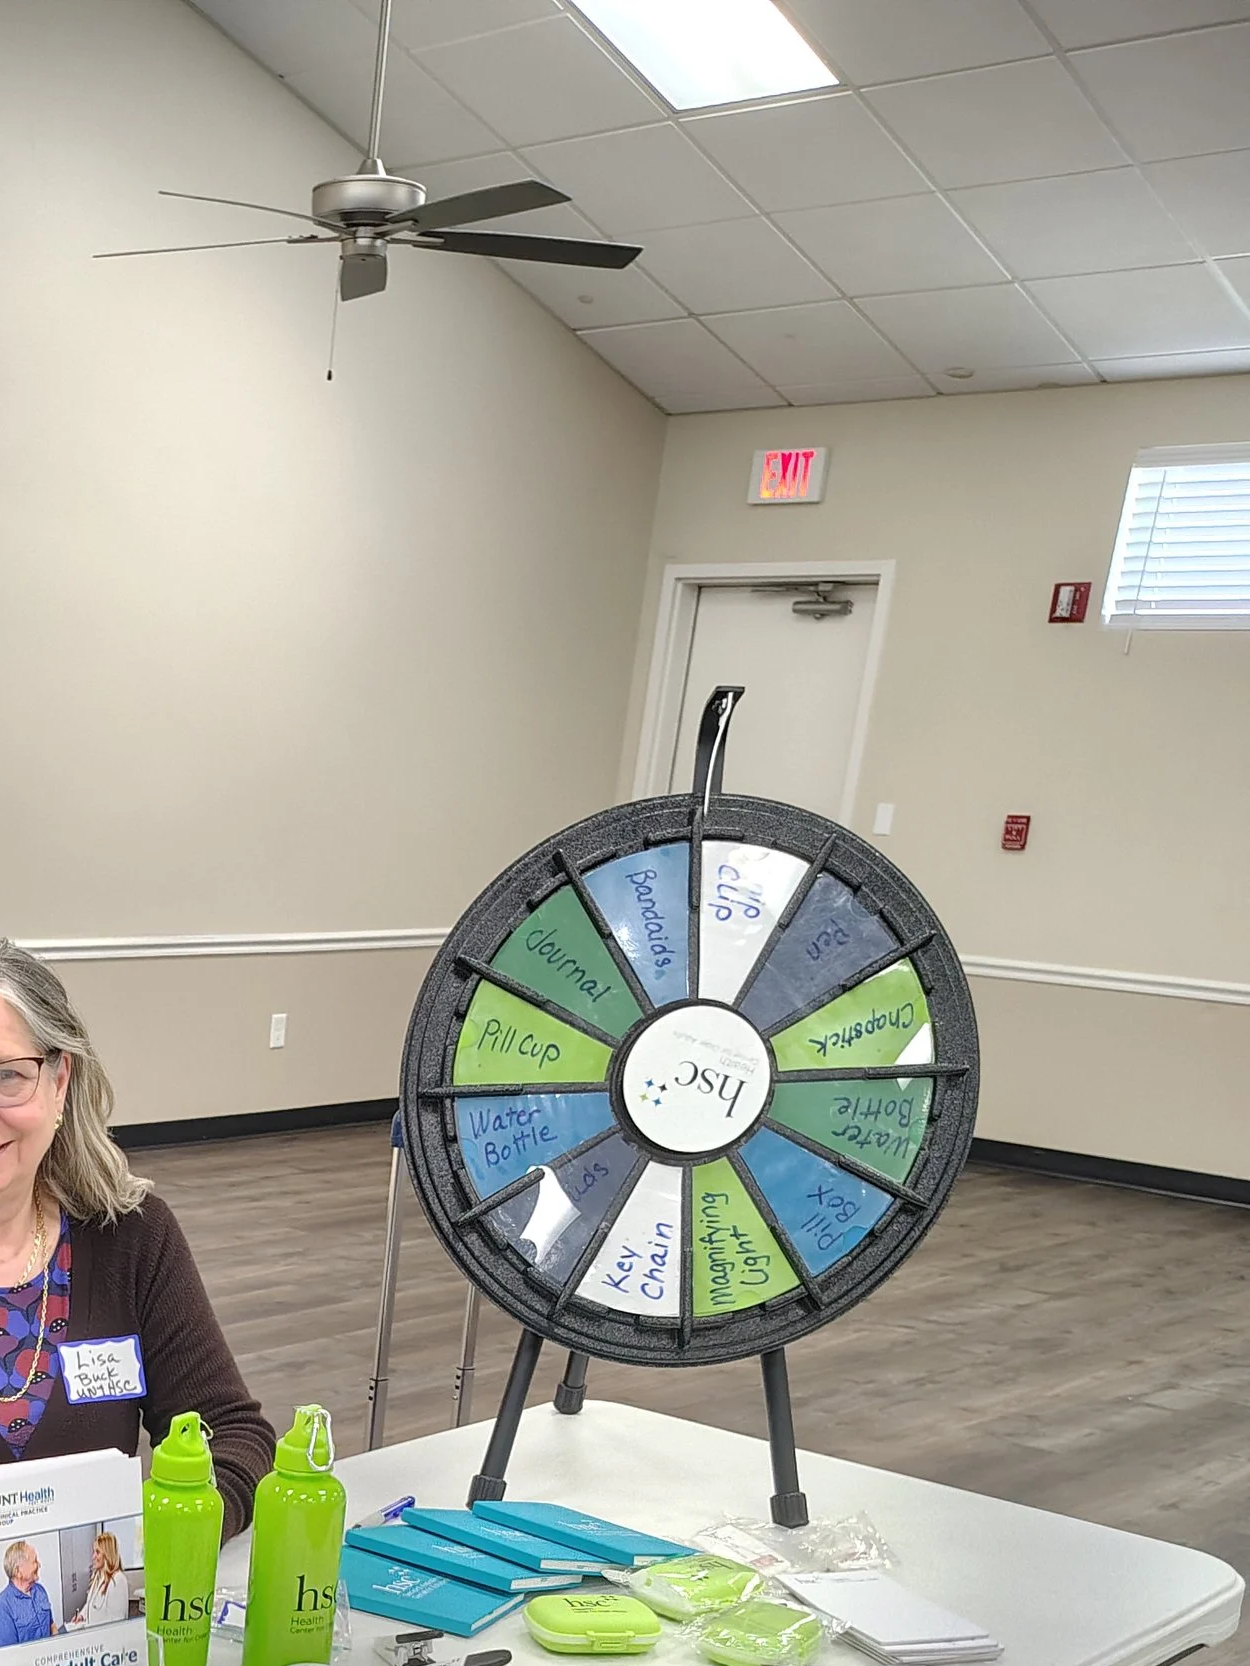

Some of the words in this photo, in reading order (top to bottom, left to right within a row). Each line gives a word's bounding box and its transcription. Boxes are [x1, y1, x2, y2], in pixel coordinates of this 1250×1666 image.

[760, 451, 816, 498] EXIT
[708, 864, 740, 922] Clip
[625, 869, 677, 968] Bandaids
[526, 928, 610, 1002] Journal
[478, 1018, 517, 1053] Pill
[518, 1034, 560, 1068] Cup
[808, 1002, 914, 1057] Chapstick
[674, 1060, 749, 1118] hsc
[470, 1106, 542, 1140] Water
[834, 1096, 914, 1128] Bottle
[484, 1126, 558, 1168] Bottle
[832, 1124, 910, 1158] Water
[807, 1184, 860, 1224] Box
[800, 1212, 844, 1251] Pill
[602, 1245, 643, 1294] Key
[640, 1222, 673, 1300] Chain
[74, 1366, 118, 1387] Buck
[76, 1350, 121, 1370] Lisa
[20, 1486, 54, 1502] Health
[294, 1574, 337, 1612] hs
[564, 1597, 609, 1608] hsc
[157, 1626, 192, 1636] Health
[290, 1615, 324, 1626] Health
[35, 1644, 104, 1666] COMPREHENSIVE
[101, 1650, 138, 1666] Care
[162, 1636, 182, 1644] enter
